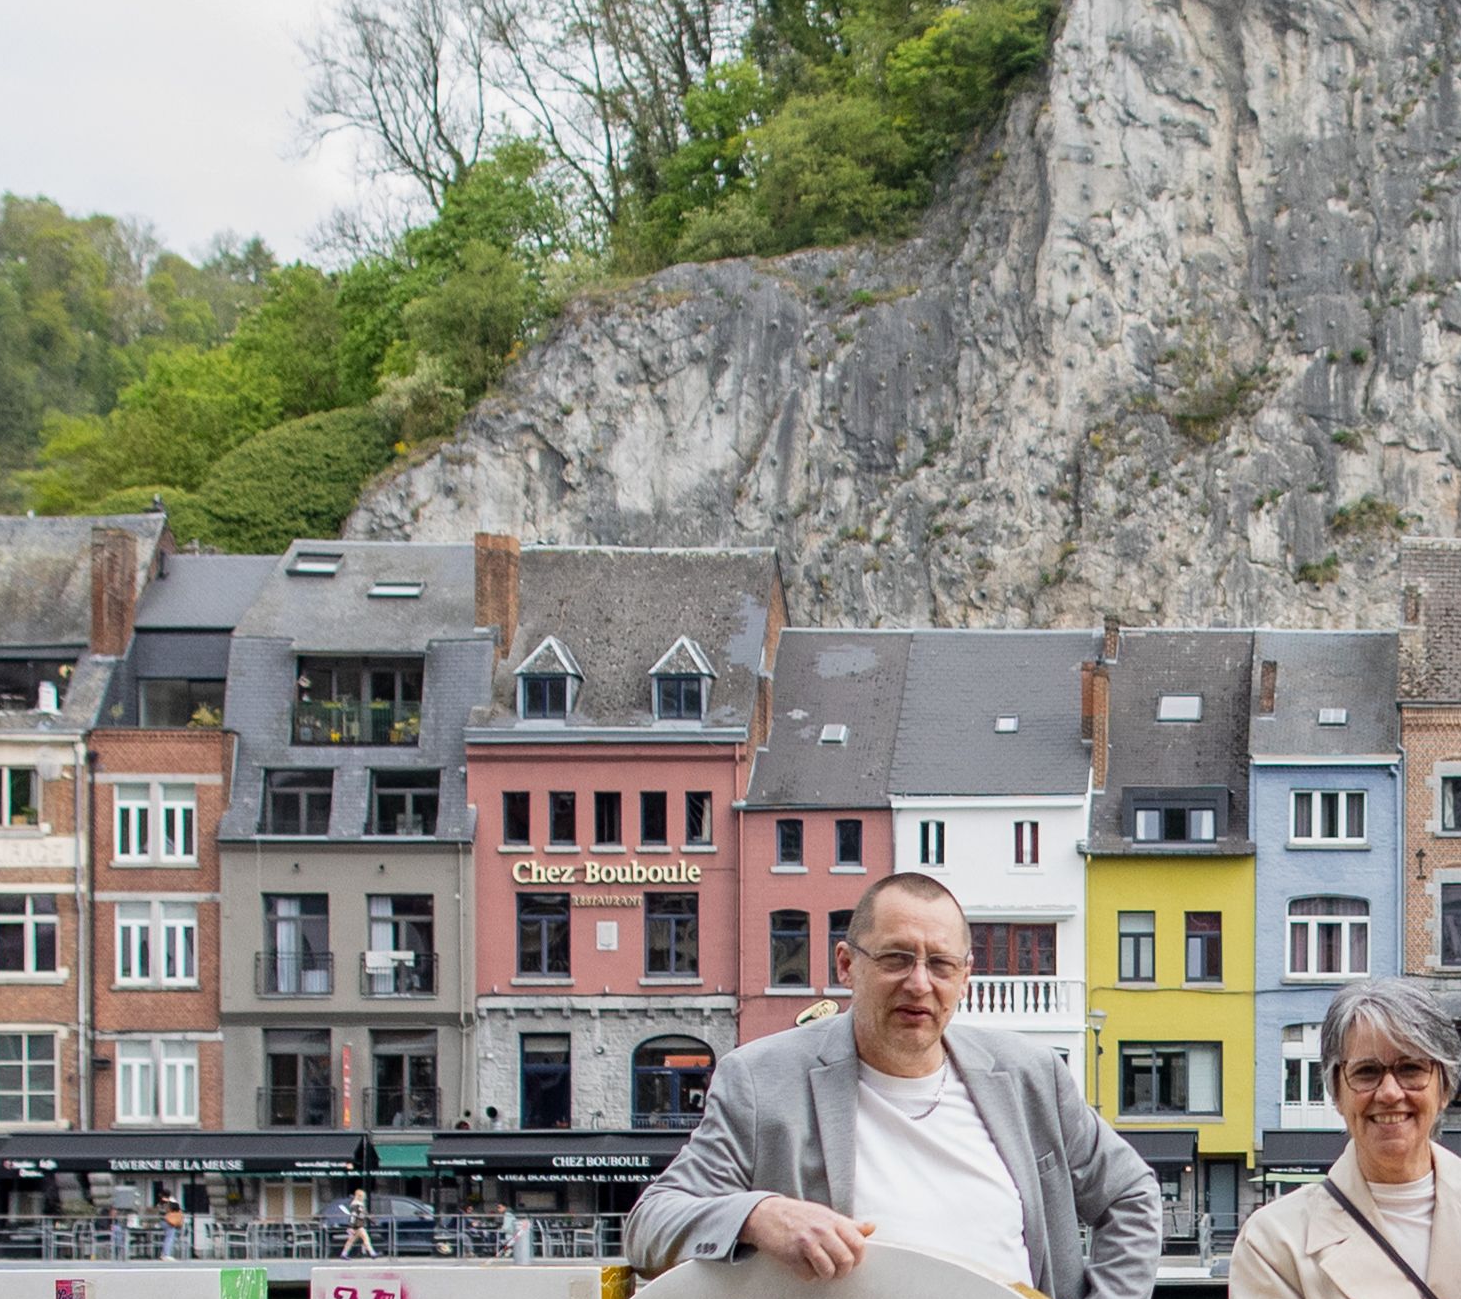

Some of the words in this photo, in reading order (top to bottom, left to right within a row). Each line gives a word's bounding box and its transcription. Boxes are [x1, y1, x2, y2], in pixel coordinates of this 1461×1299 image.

[512, 860, 576, 884] Chez
[584, 859, 701, 884] Bouboule
[571, 894, 642, 907] RESTAURANT
[108, 1159, 164, 1171] TAVERNE
[165, 1159, 182, 1171] DE
[183, 1159, 200, 1171] LA
[202, 1159, 244, 1171] MEUSE
[552, 1156, 582, 1168] CHEZ
[585, 1156, 651, 1168] BOUBOULE
